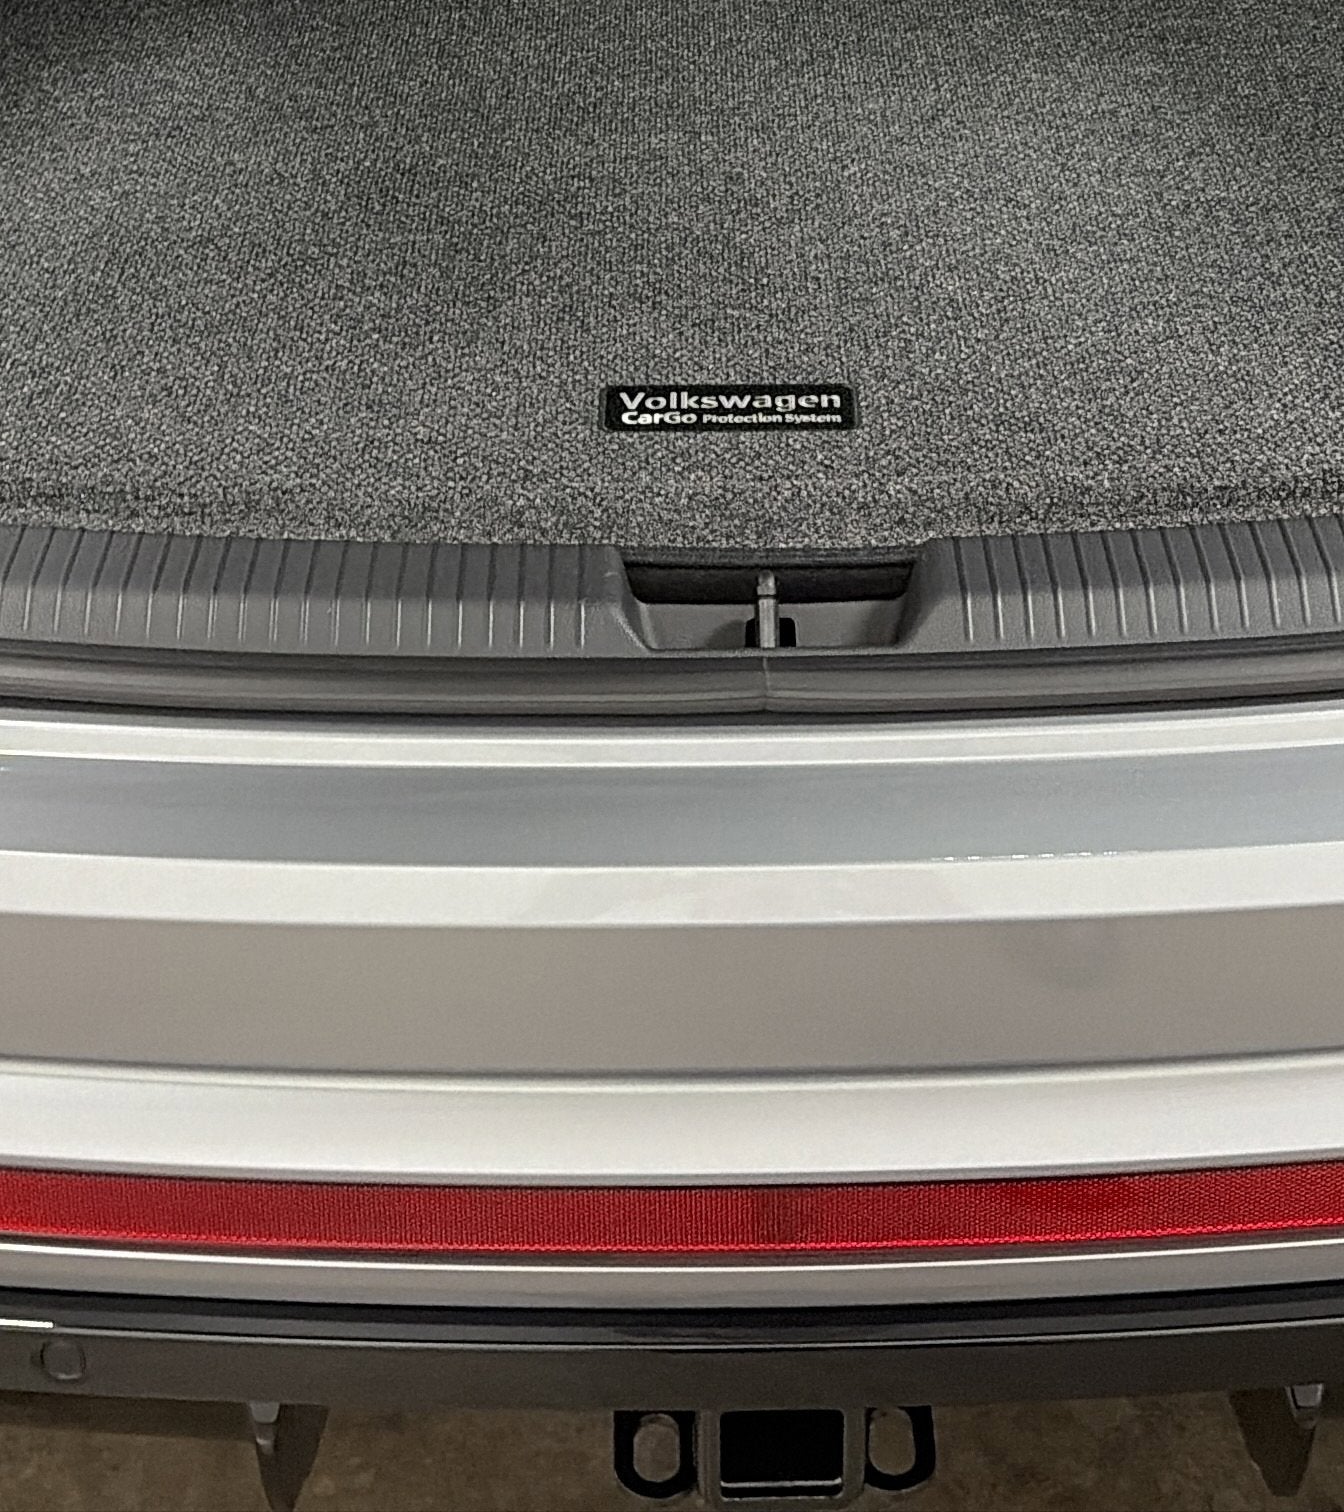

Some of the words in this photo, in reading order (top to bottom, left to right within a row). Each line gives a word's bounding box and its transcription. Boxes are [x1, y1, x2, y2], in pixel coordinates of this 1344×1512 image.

[619, 391, 841, 412] Volkswagen
[621, 411, 698, 425] CarGo
[702, 412, 783, 424] Protection
[784, 413, 843, 425] System
